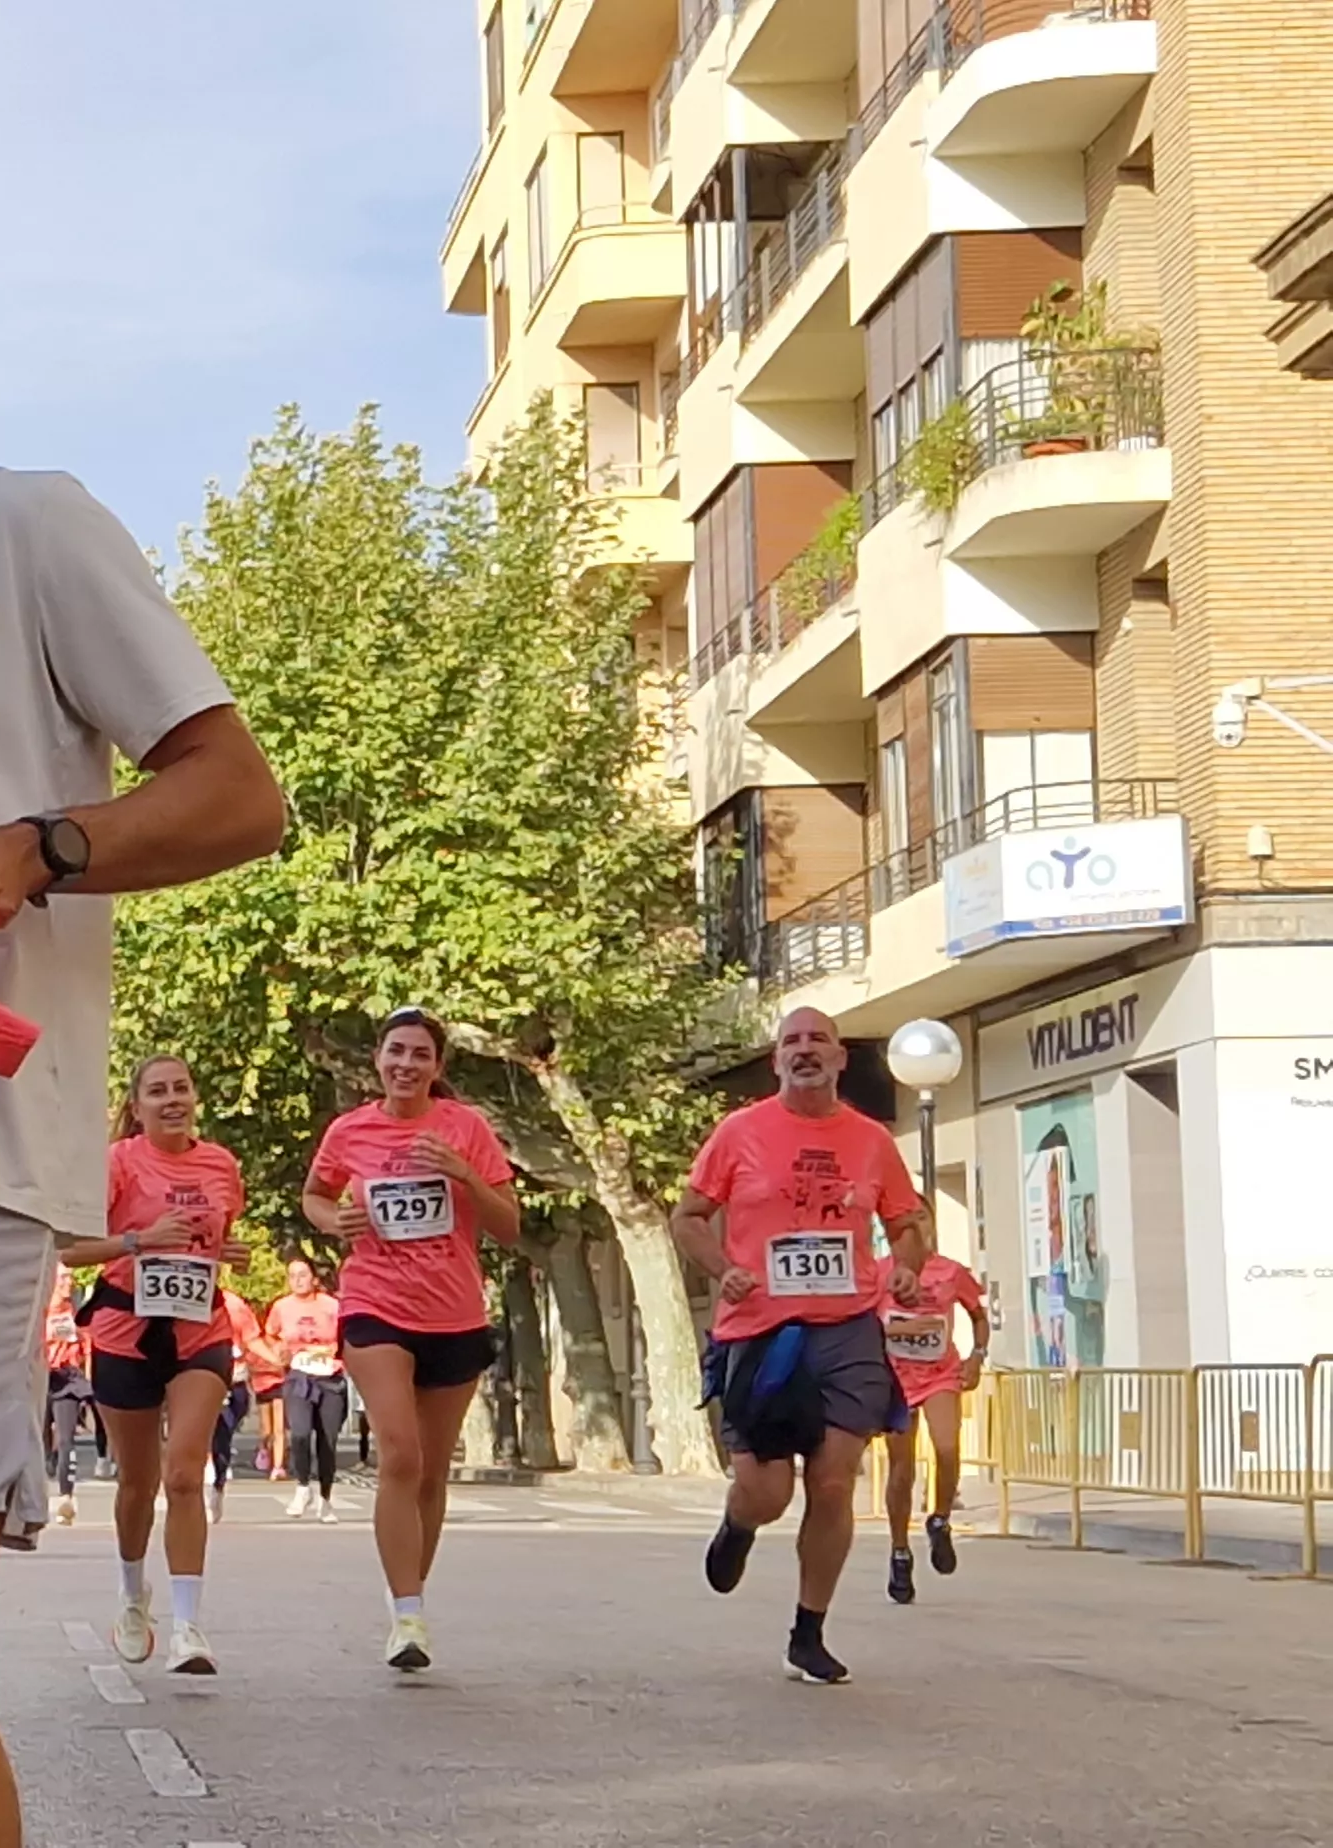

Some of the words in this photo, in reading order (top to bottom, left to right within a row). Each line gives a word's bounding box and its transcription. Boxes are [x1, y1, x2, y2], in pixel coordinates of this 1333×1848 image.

[1026, 993, 1139, 1071] VITALDENT
[376, 1196, 444, 1223] 1297
[778, 1252, 844, 1278] 1301
[145, 1274, 208, 1303] 3632
